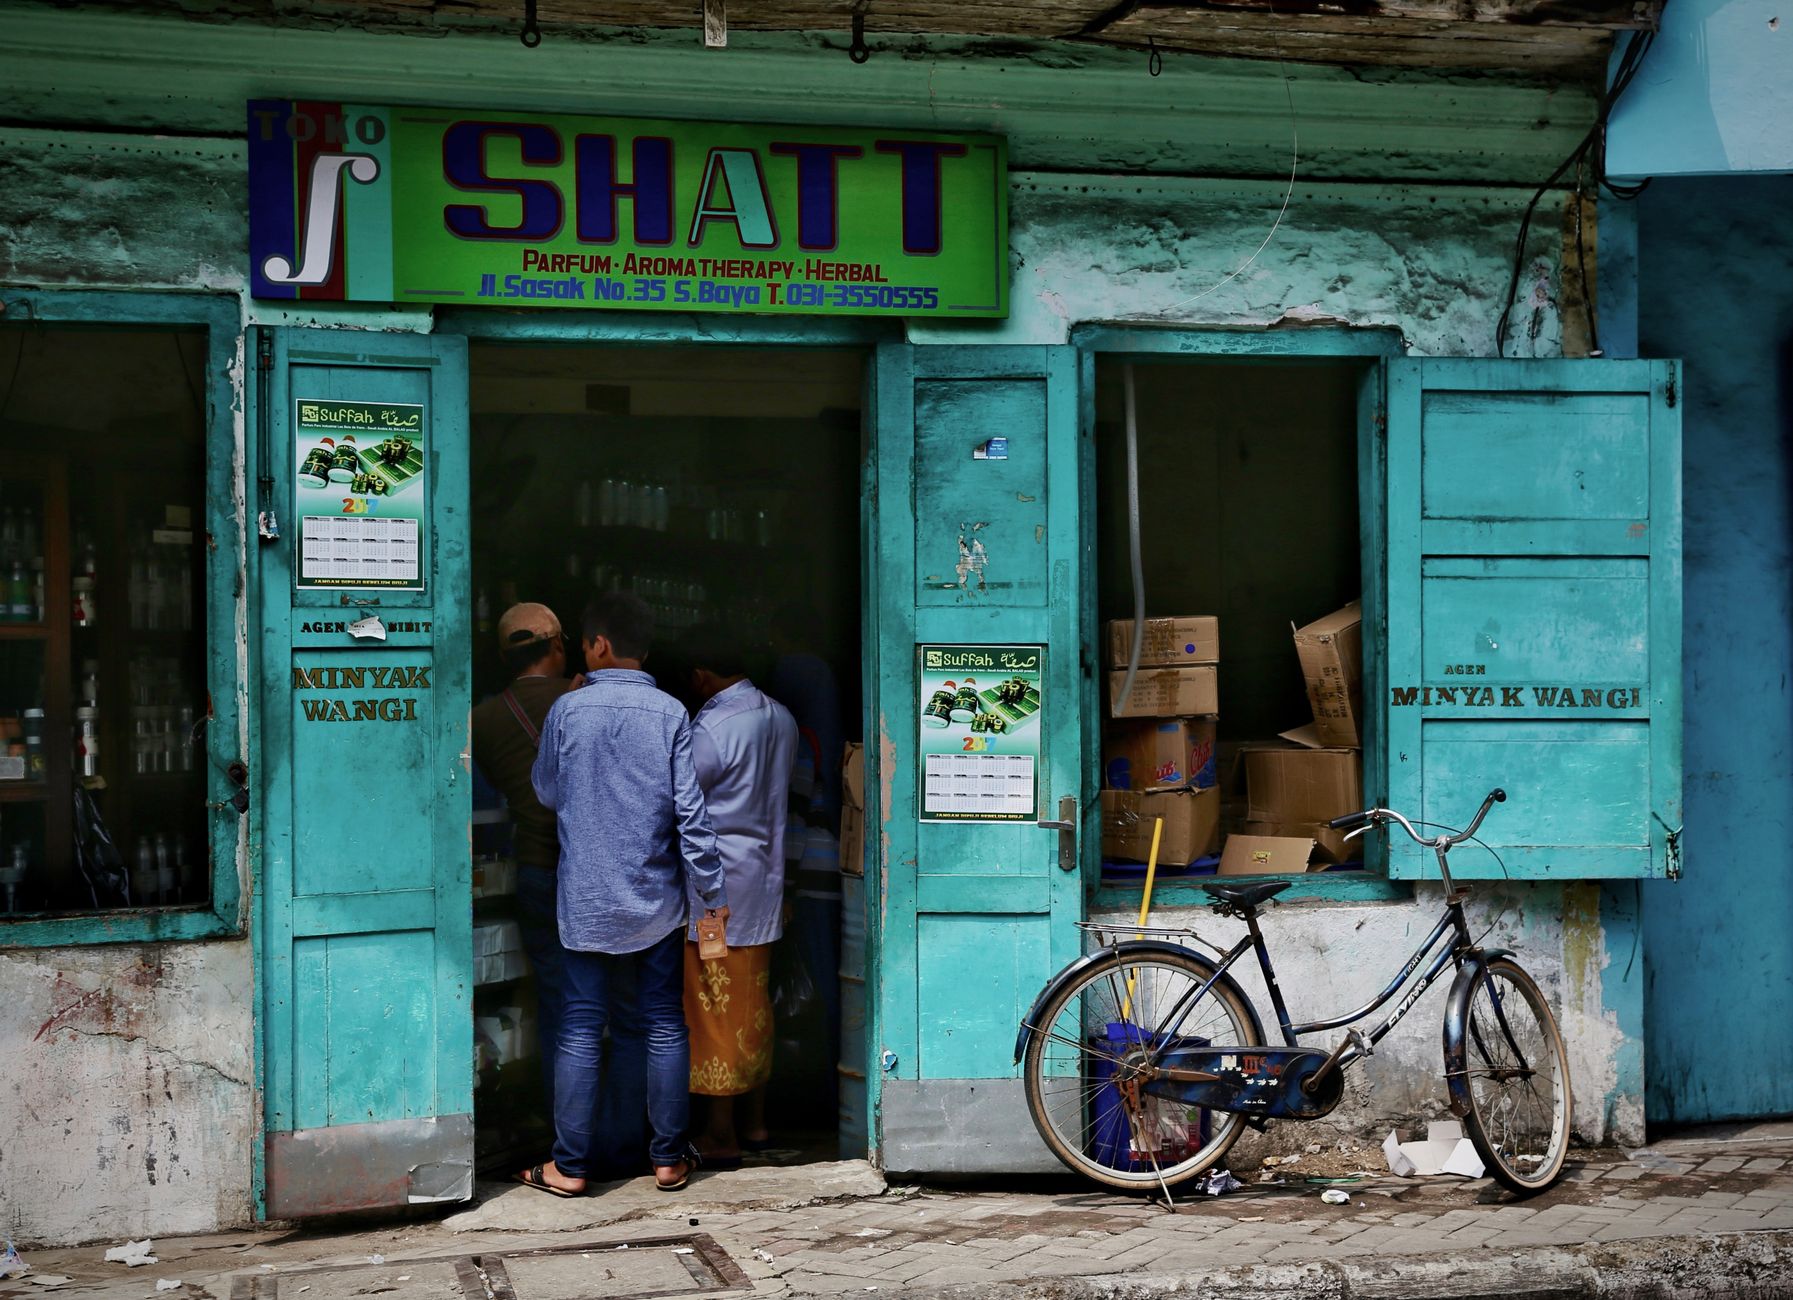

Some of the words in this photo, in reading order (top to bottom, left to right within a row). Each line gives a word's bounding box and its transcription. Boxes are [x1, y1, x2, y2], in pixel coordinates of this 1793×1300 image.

[253, 110, 386, 145] TOKO
[441, 119, 968, 255] SHATT
[523, 248, 611, 274] PARFUM
[805, 259, 888, 282] HERBAL
[594, 277, 666, 301] No.35
[673, 279, 760, 308] S.Baya
[320, 407, 374, 424] Suffah
[301, 621, 345, 633] AGEN
[943, 653, 993, 666] Suffah
[1444, 664, 1486, 675] AGEN
[292, 666, 431, 689] MINYAK
[1391, 686, 1524, 707] MINYAK
[1532, 687, 1642, 709] WANGI
[301, 698, 417, 721] WANGI
